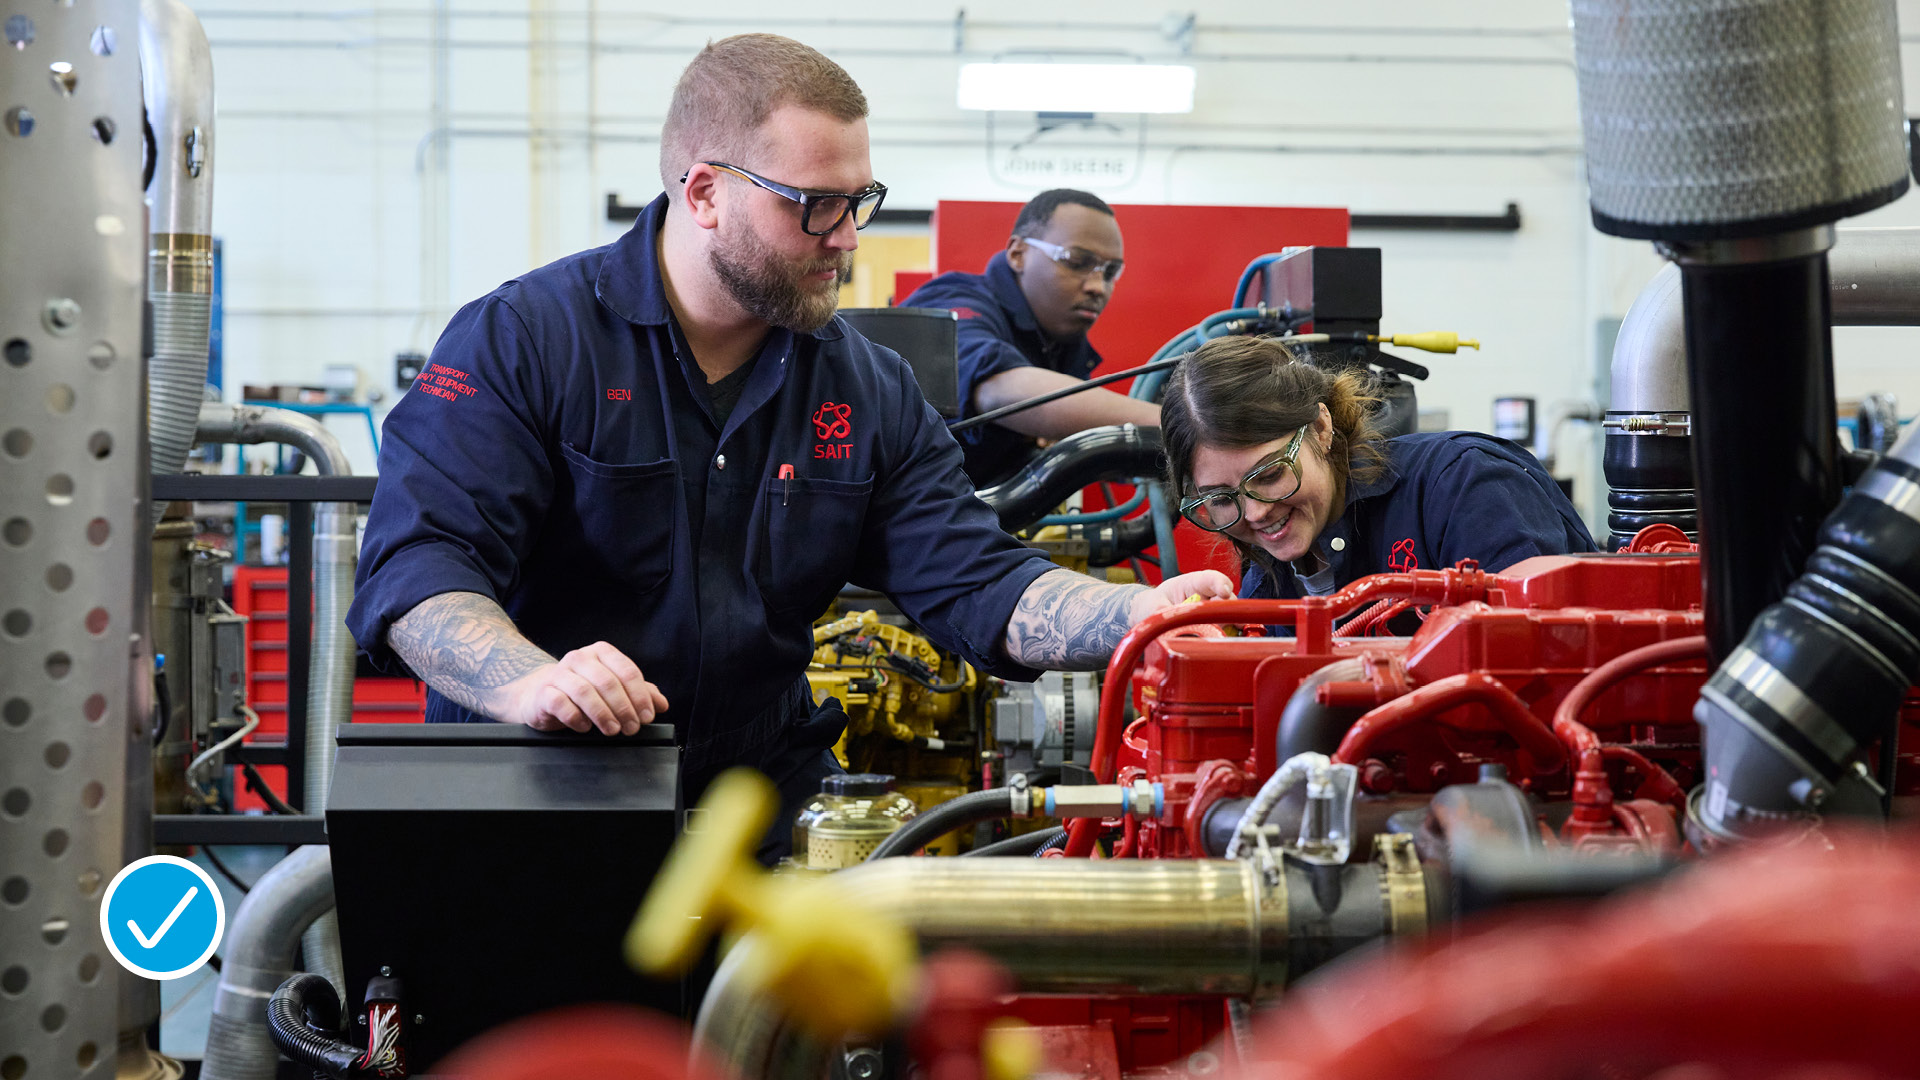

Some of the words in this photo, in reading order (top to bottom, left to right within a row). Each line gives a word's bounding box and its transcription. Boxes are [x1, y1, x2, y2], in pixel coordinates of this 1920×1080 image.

[430, 363, 470, 381] TRANSPORT
[419, 382, 458, 402] TECHNICIAN
[435, 375, 478, 397] EQUIPMENT
[607, 388, 632, 401] BEN
[814, 443, 854, 459] SAIT
